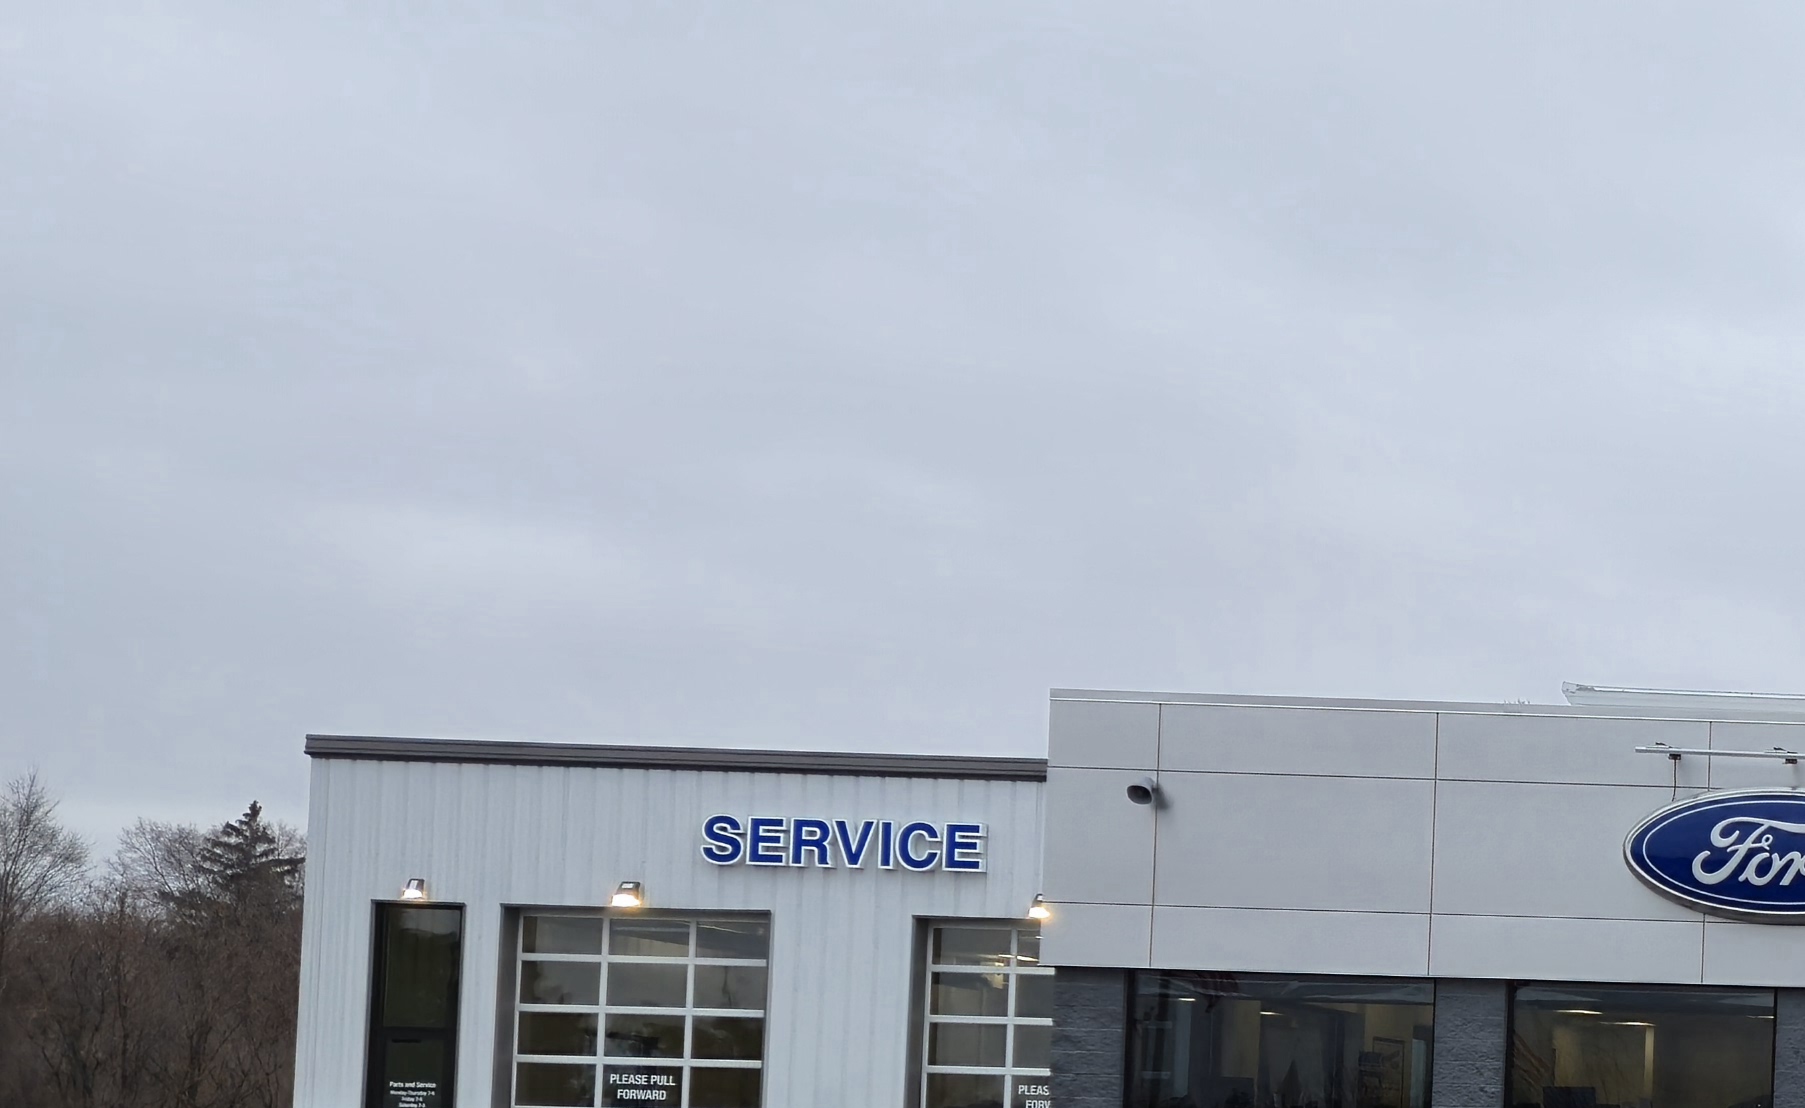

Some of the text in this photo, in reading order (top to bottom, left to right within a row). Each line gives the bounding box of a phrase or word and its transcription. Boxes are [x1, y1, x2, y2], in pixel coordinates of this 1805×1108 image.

[701, 814, 988, 873] SERVICE
[610, 1074, 677, 1086] PLEASE PULL
[617, 1089, 667, 1100] FORWARD
